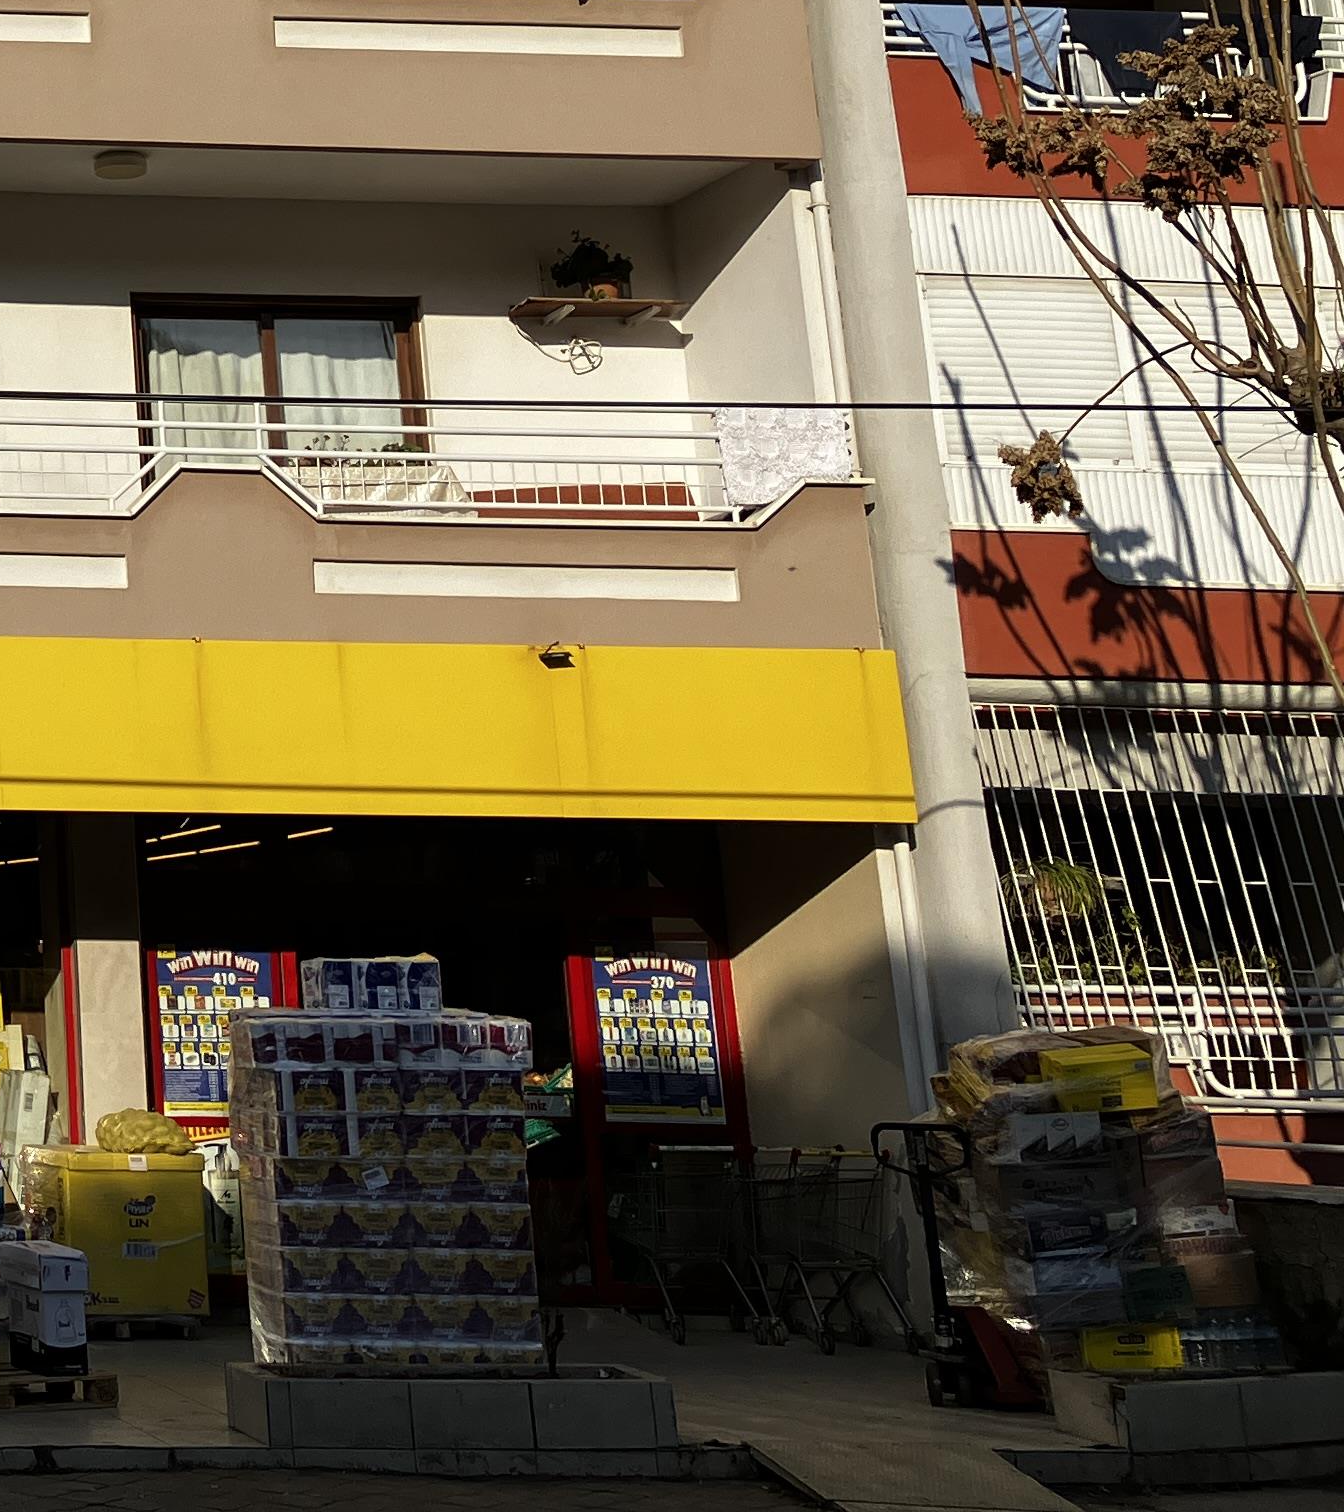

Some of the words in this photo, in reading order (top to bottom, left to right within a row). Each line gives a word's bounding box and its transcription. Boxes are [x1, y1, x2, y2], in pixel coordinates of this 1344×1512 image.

[213, 972, 238, 986] 410
[650, 975, 675, 989] 370
[129, 1218, 150, 1228] UN
